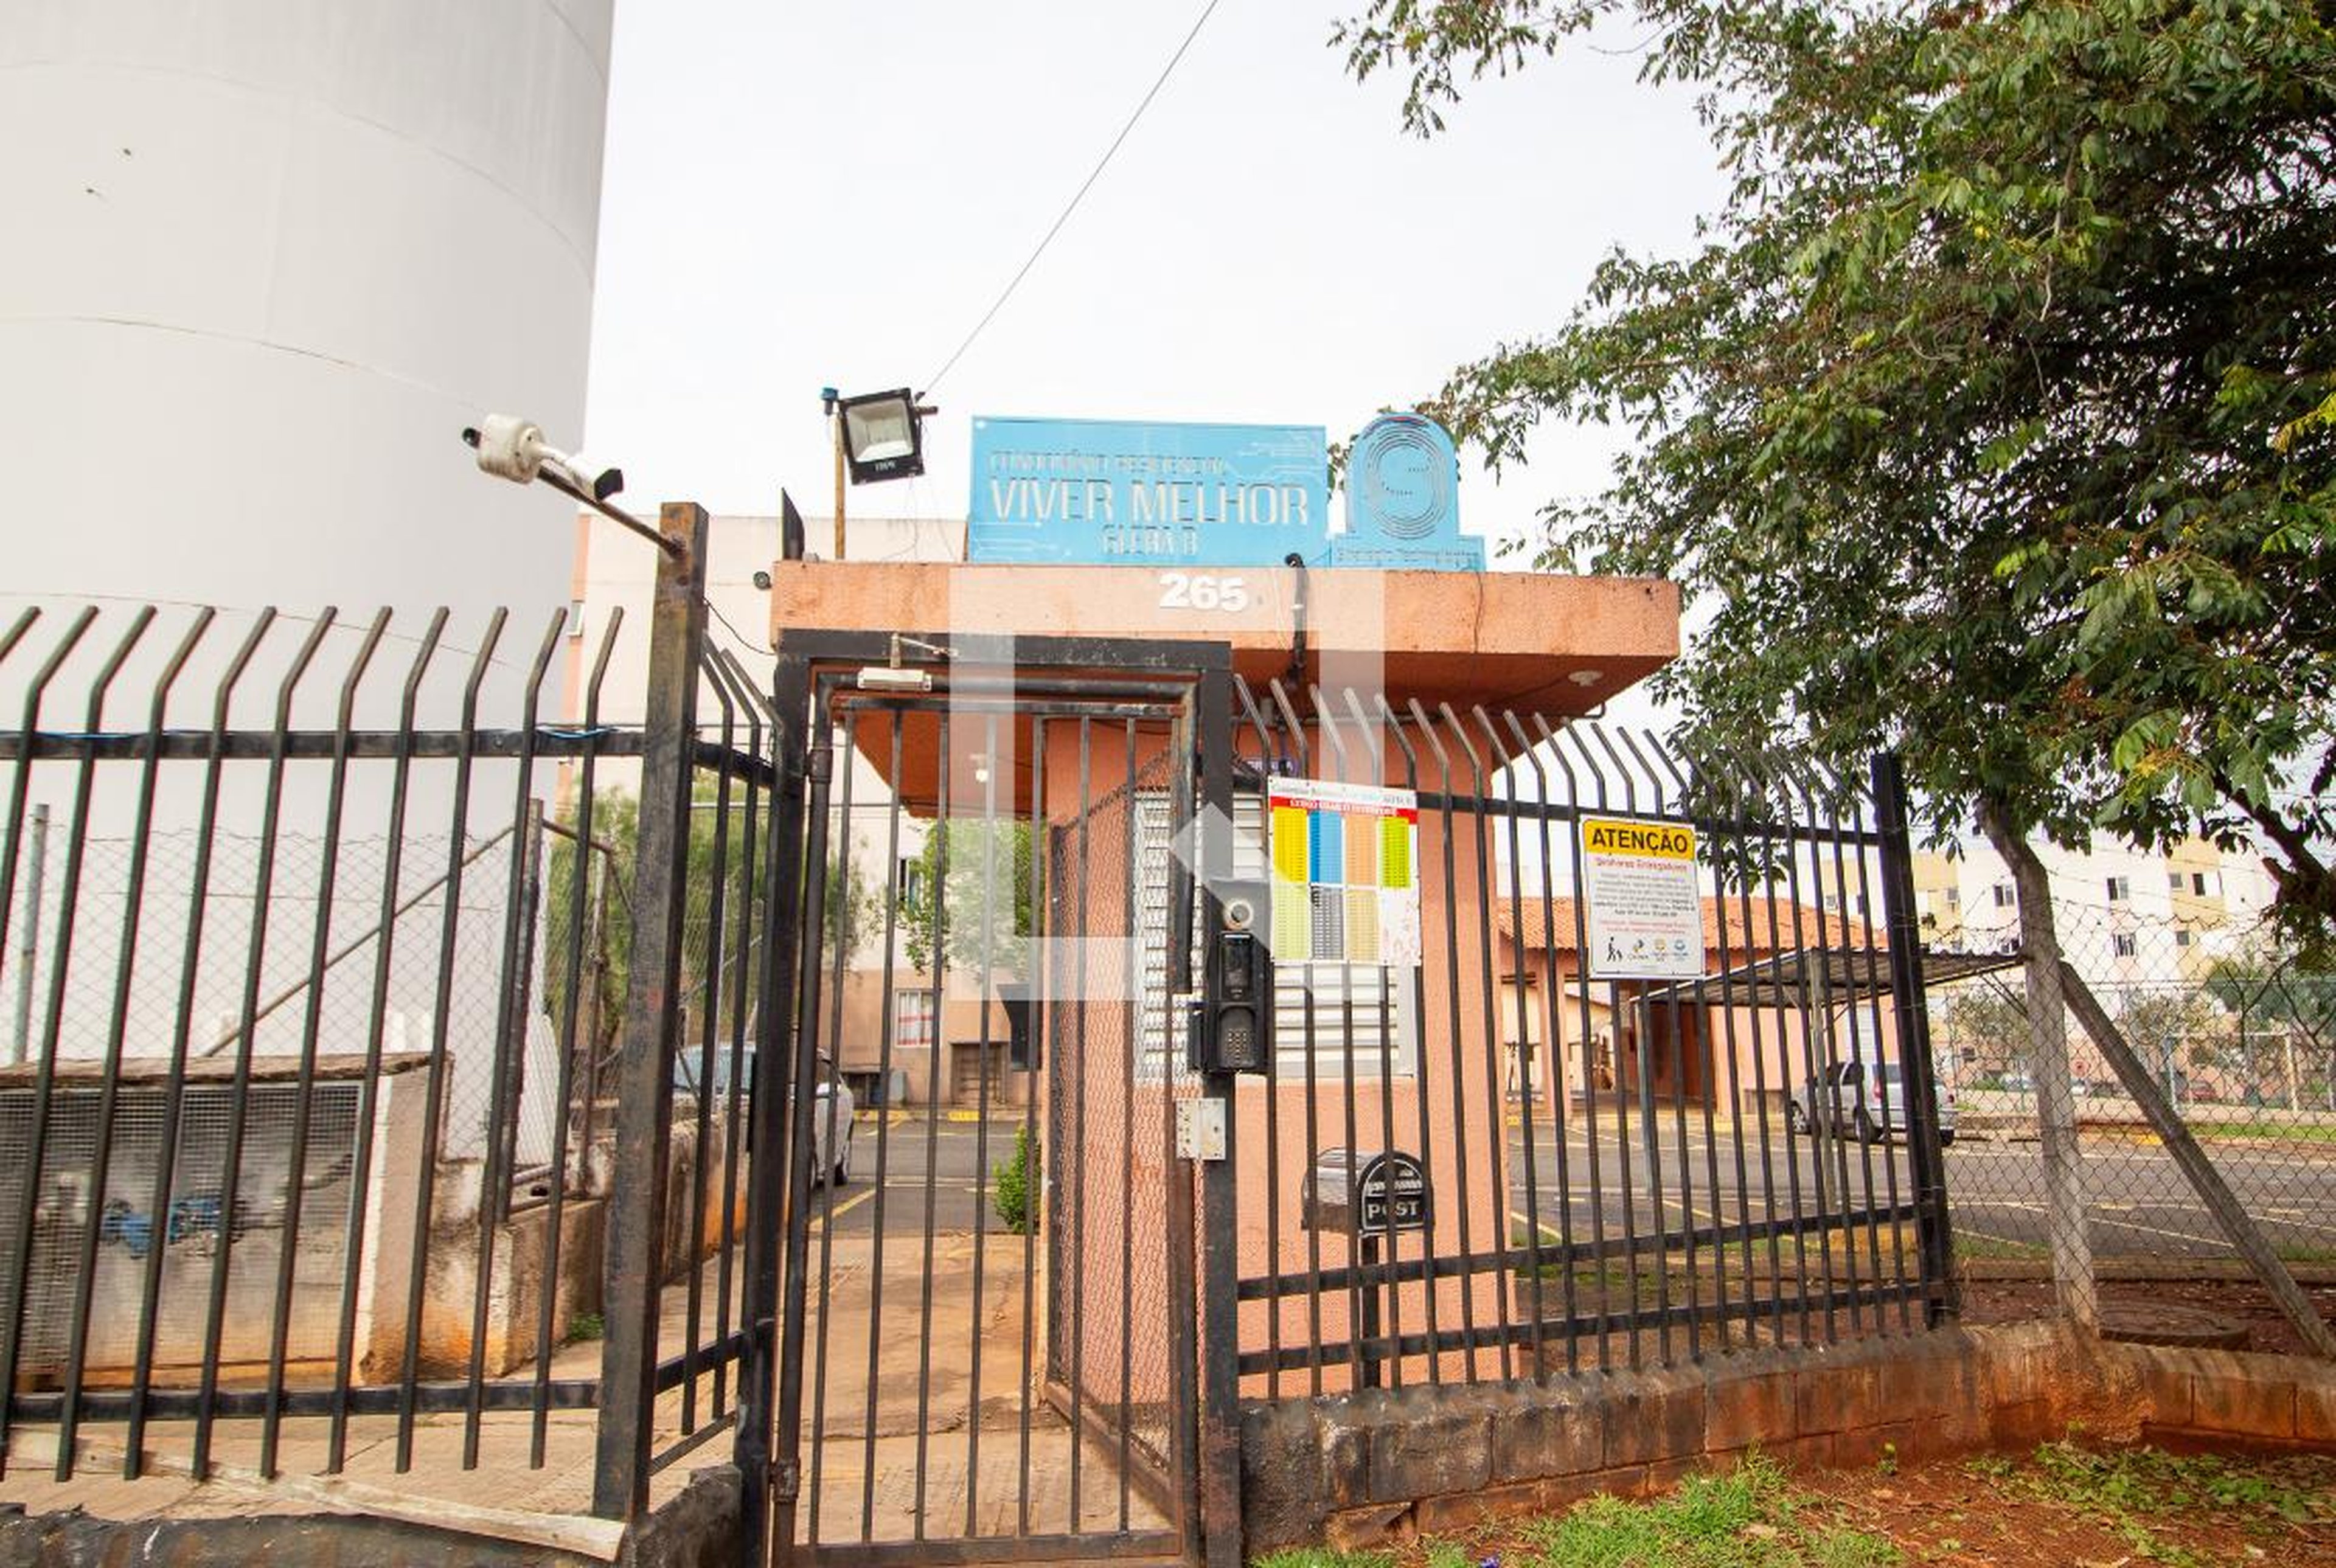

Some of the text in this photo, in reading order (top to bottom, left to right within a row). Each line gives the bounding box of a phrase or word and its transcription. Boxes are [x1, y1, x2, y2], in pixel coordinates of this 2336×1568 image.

[990, 477, 1308, 526] VIVER MELHOR
[1159, 571, 1248, 612] 265
[1592, 828, 1688, 853] ATENÇÃO
